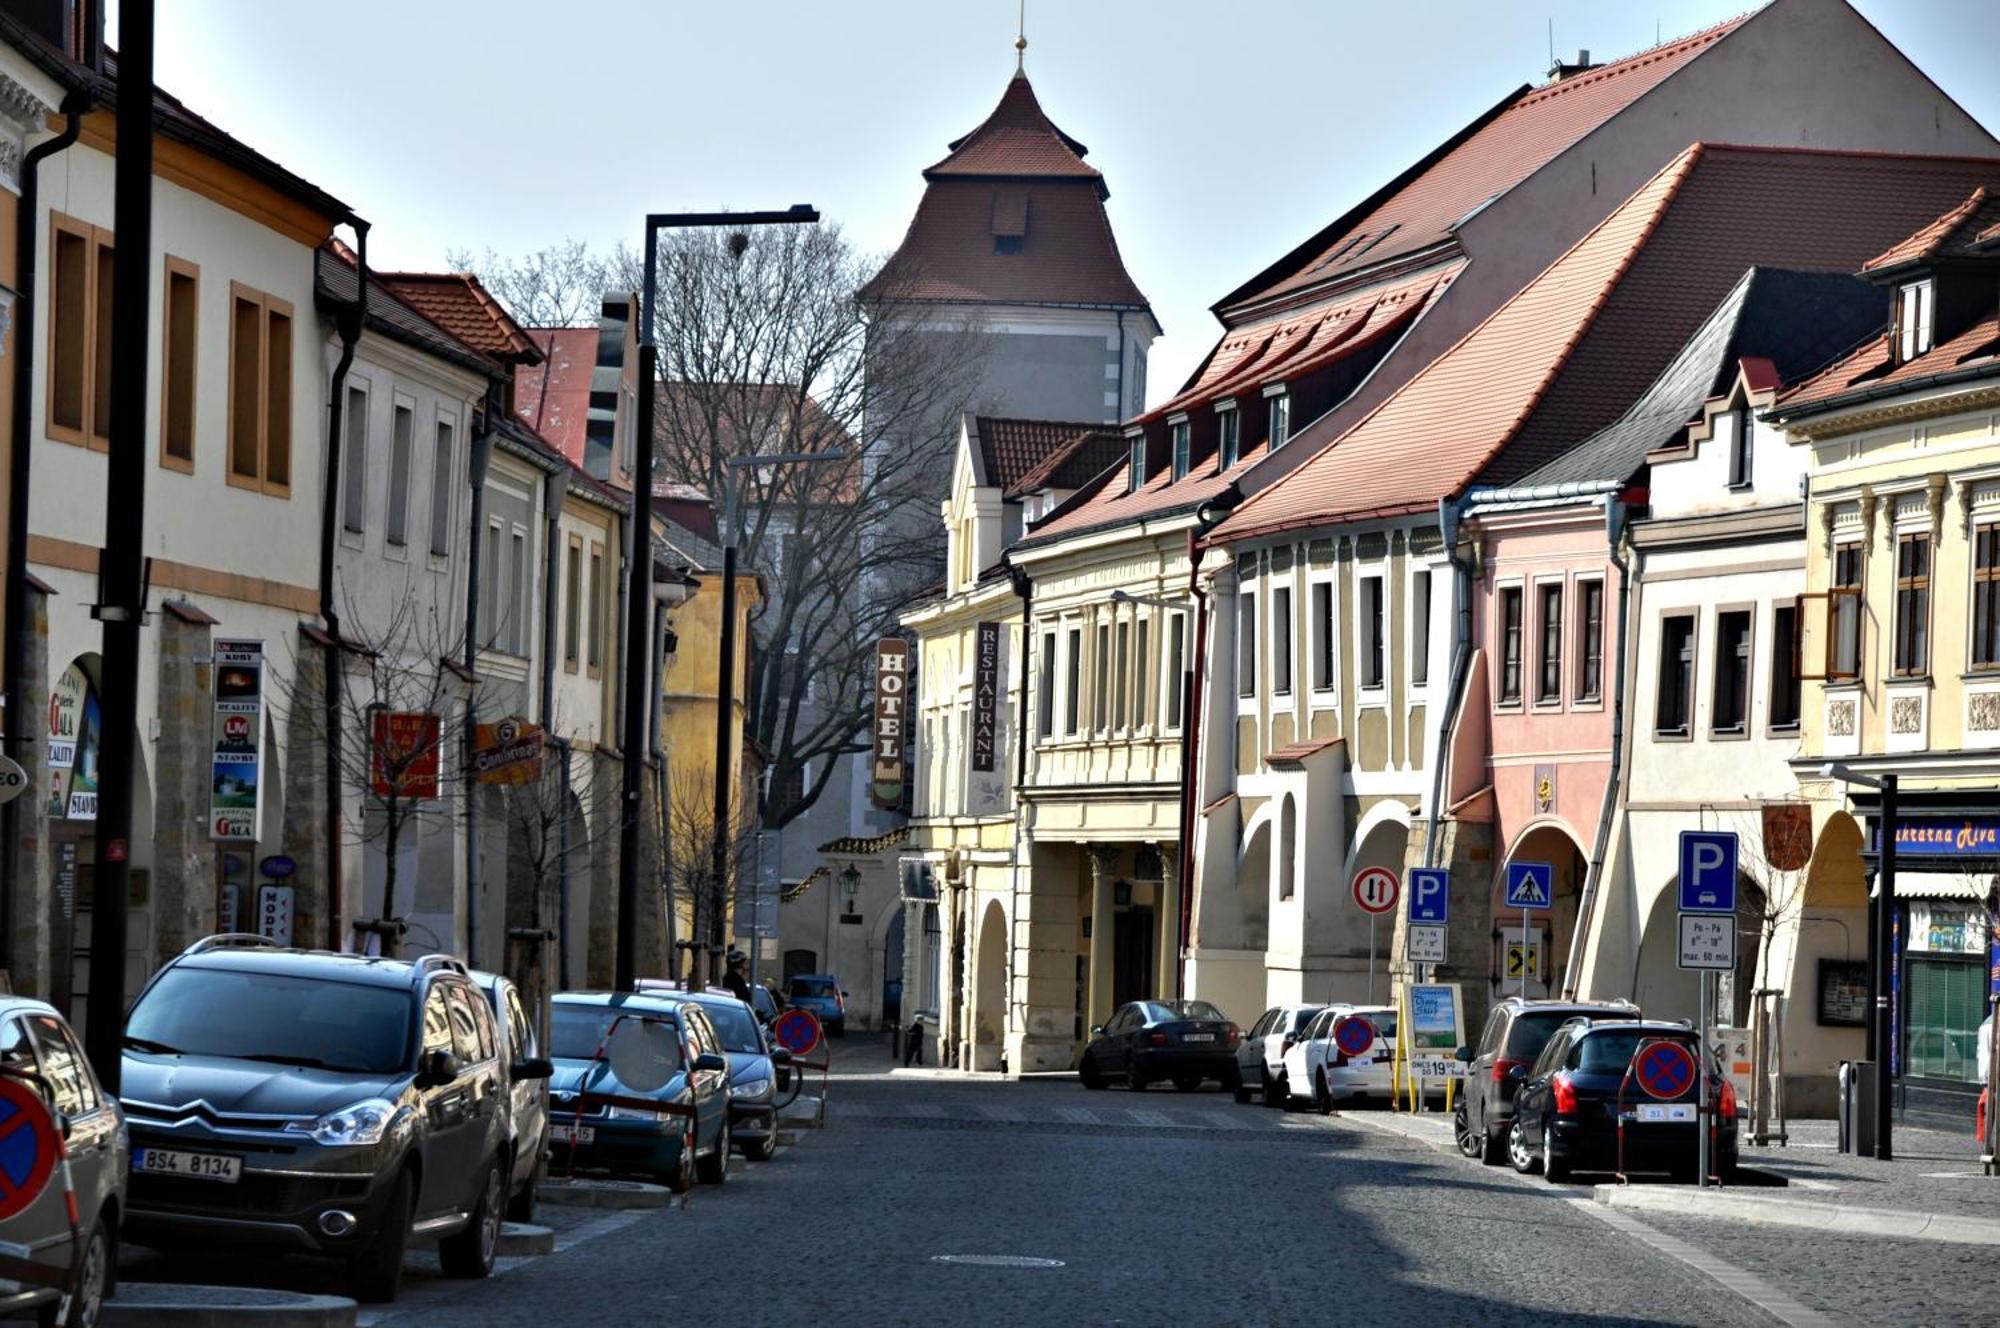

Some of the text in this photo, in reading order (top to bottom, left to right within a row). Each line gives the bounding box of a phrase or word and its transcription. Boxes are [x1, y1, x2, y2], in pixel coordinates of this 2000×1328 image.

[879, 654, 904, 757] HOTEL
[976, 630, 995, 766] RESTAURANT
[226, 721, 248, 734] LM
[1691, 842, 1725, 886] P
[1417, 875, 1441, 906] P
[1432, 1061, 1446, 1076] 19
[147, 1151, 231, 1176] 8S4 8134
